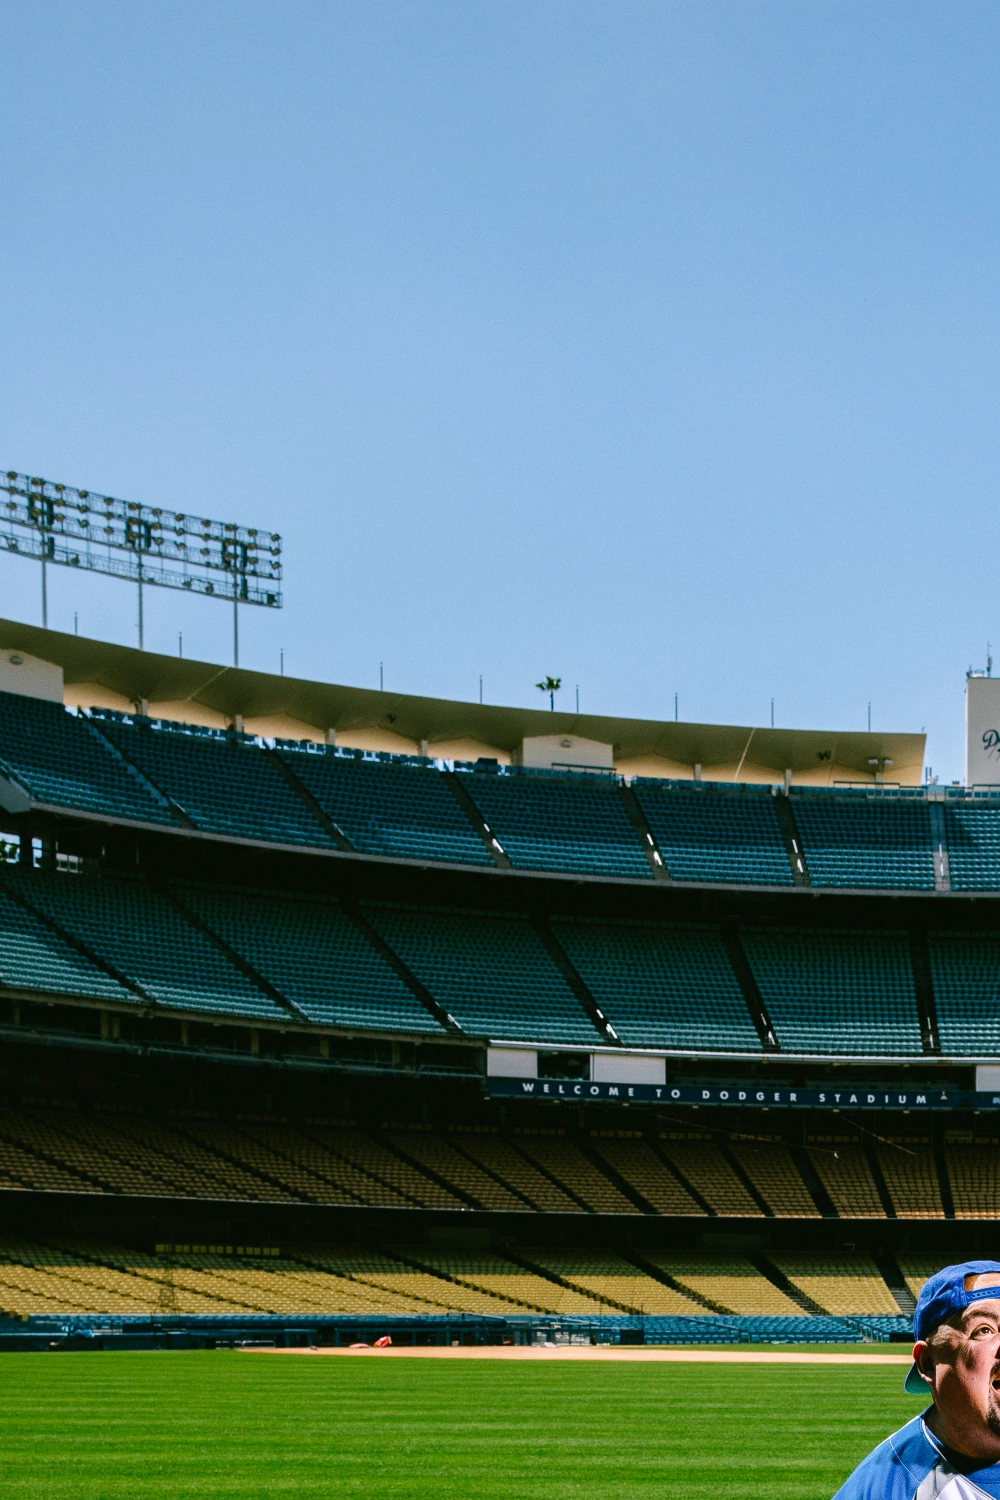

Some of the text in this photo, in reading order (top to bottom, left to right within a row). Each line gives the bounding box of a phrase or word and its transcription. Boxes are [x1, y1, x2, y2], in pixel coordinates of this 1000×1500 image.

[522, 1082, 927, 1104] WELCOME TO DODGER STADIUM
